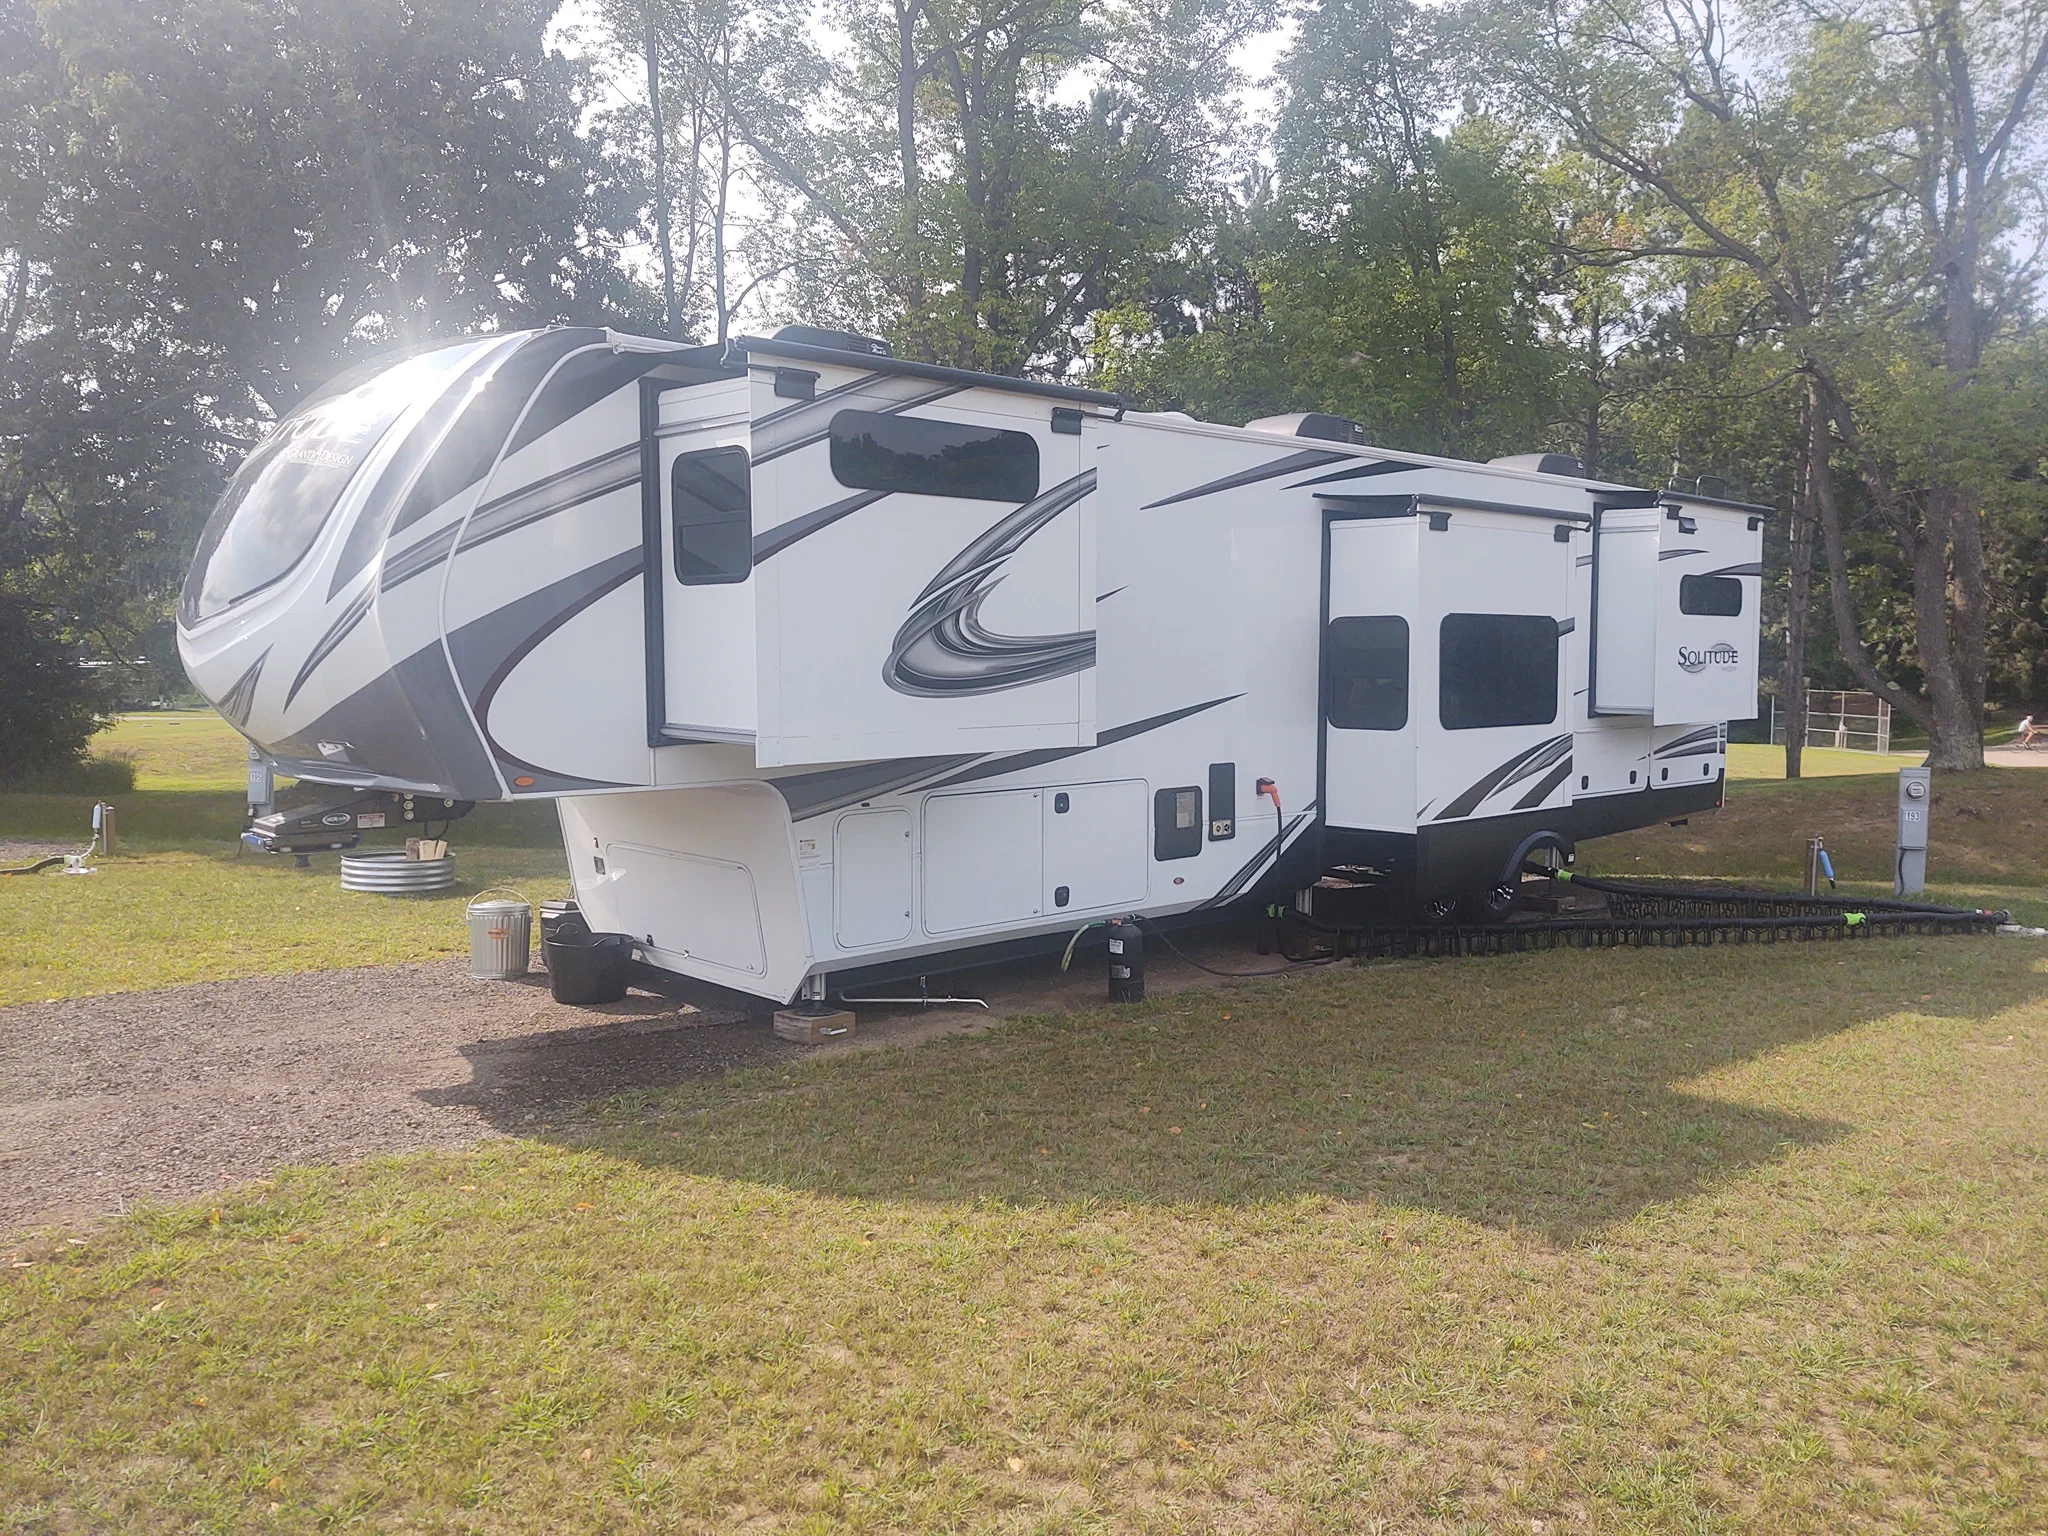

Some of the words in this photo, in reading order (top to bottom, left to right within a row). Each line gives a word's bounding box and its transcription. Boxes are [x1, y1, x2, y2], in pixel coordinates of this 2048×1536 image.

[287, 449, 317, 462] GRAND
[319, 449, 354, 465] DESIGN
[1677, 646, 1739, 666] SOLITUDE
[1906, 811, 1920, 821] 193
